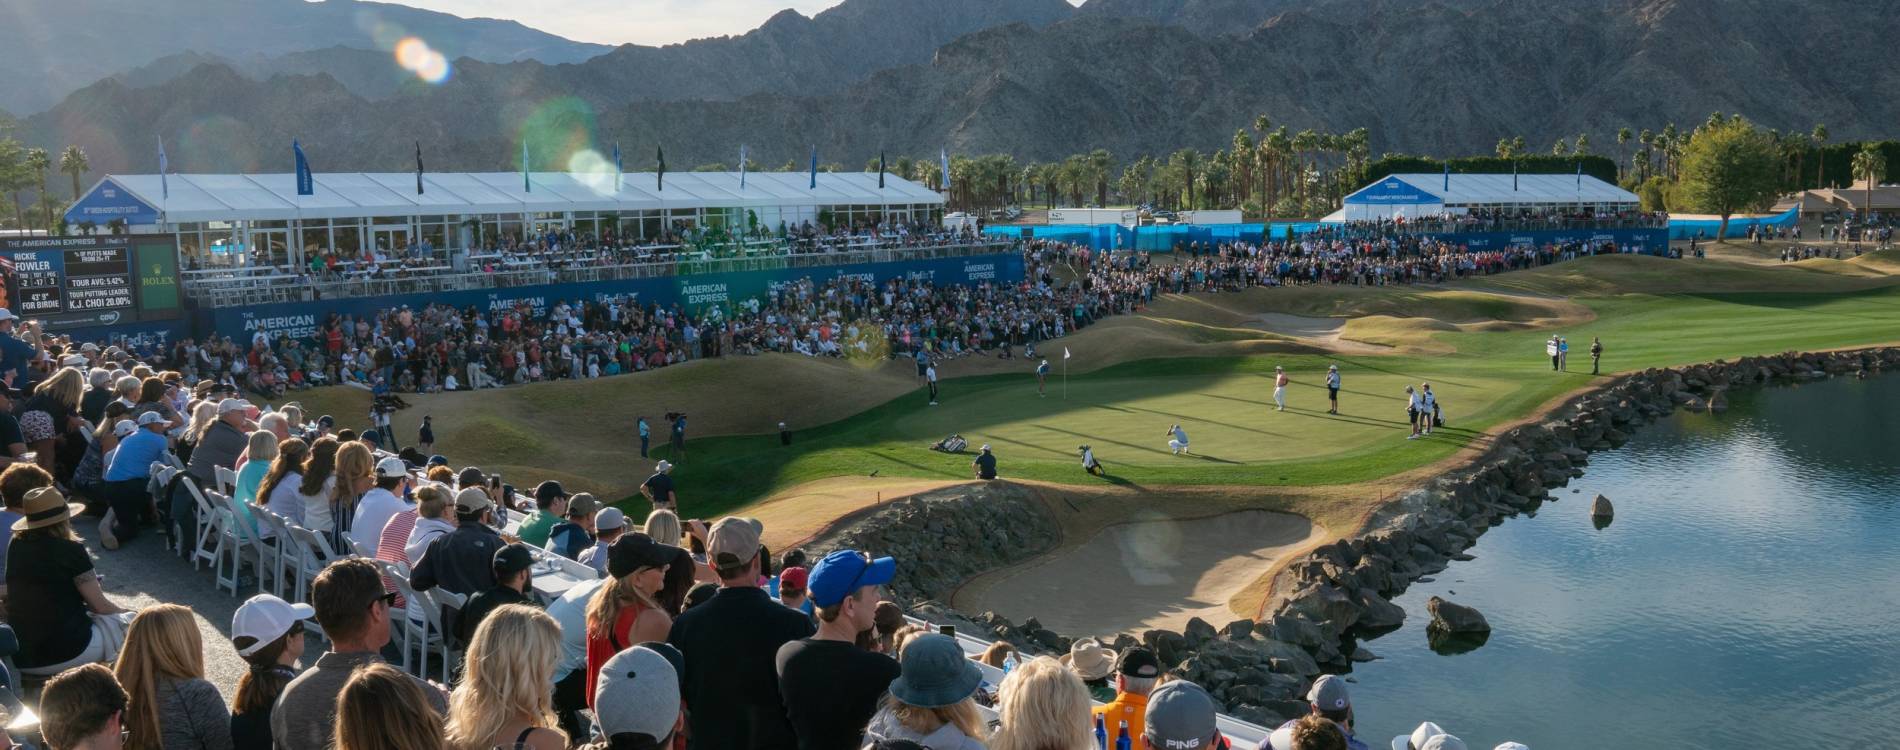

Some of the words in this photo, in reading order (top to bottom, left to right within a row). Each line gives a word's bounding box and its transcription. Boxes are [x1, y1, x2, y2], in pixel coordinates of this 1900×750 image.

[14, 252, 37, 261] RICKIE
[15, 261, 50, 271] FOWLER
[964, 263, 995, 273] AMERICAN
[106, 277, 125, 285] 5.42%
[143, 276, 175, 286] ROLEX
[968, 271, 995, 281] EXPRESS
[21, 279, 28, 287] -2
[108, 288, 129, 296] LEADER
[681, 283, 727, 296] AMERICAN
[70, 300, 84, 309] K.J.
[86, 298, 104, 308] CHOI
[105, 297, 130, 307] 20.00%
[688, 292, 728, 304] EXPRESS
[22, 302, 36, 310] FOR
[36, 300, 60, 309] BIRDIE
[244, 314, 315, 331] AMERICAN
[265, 326, 316, 341] XPRESS
[1166, 738, 1199, 749] PING
